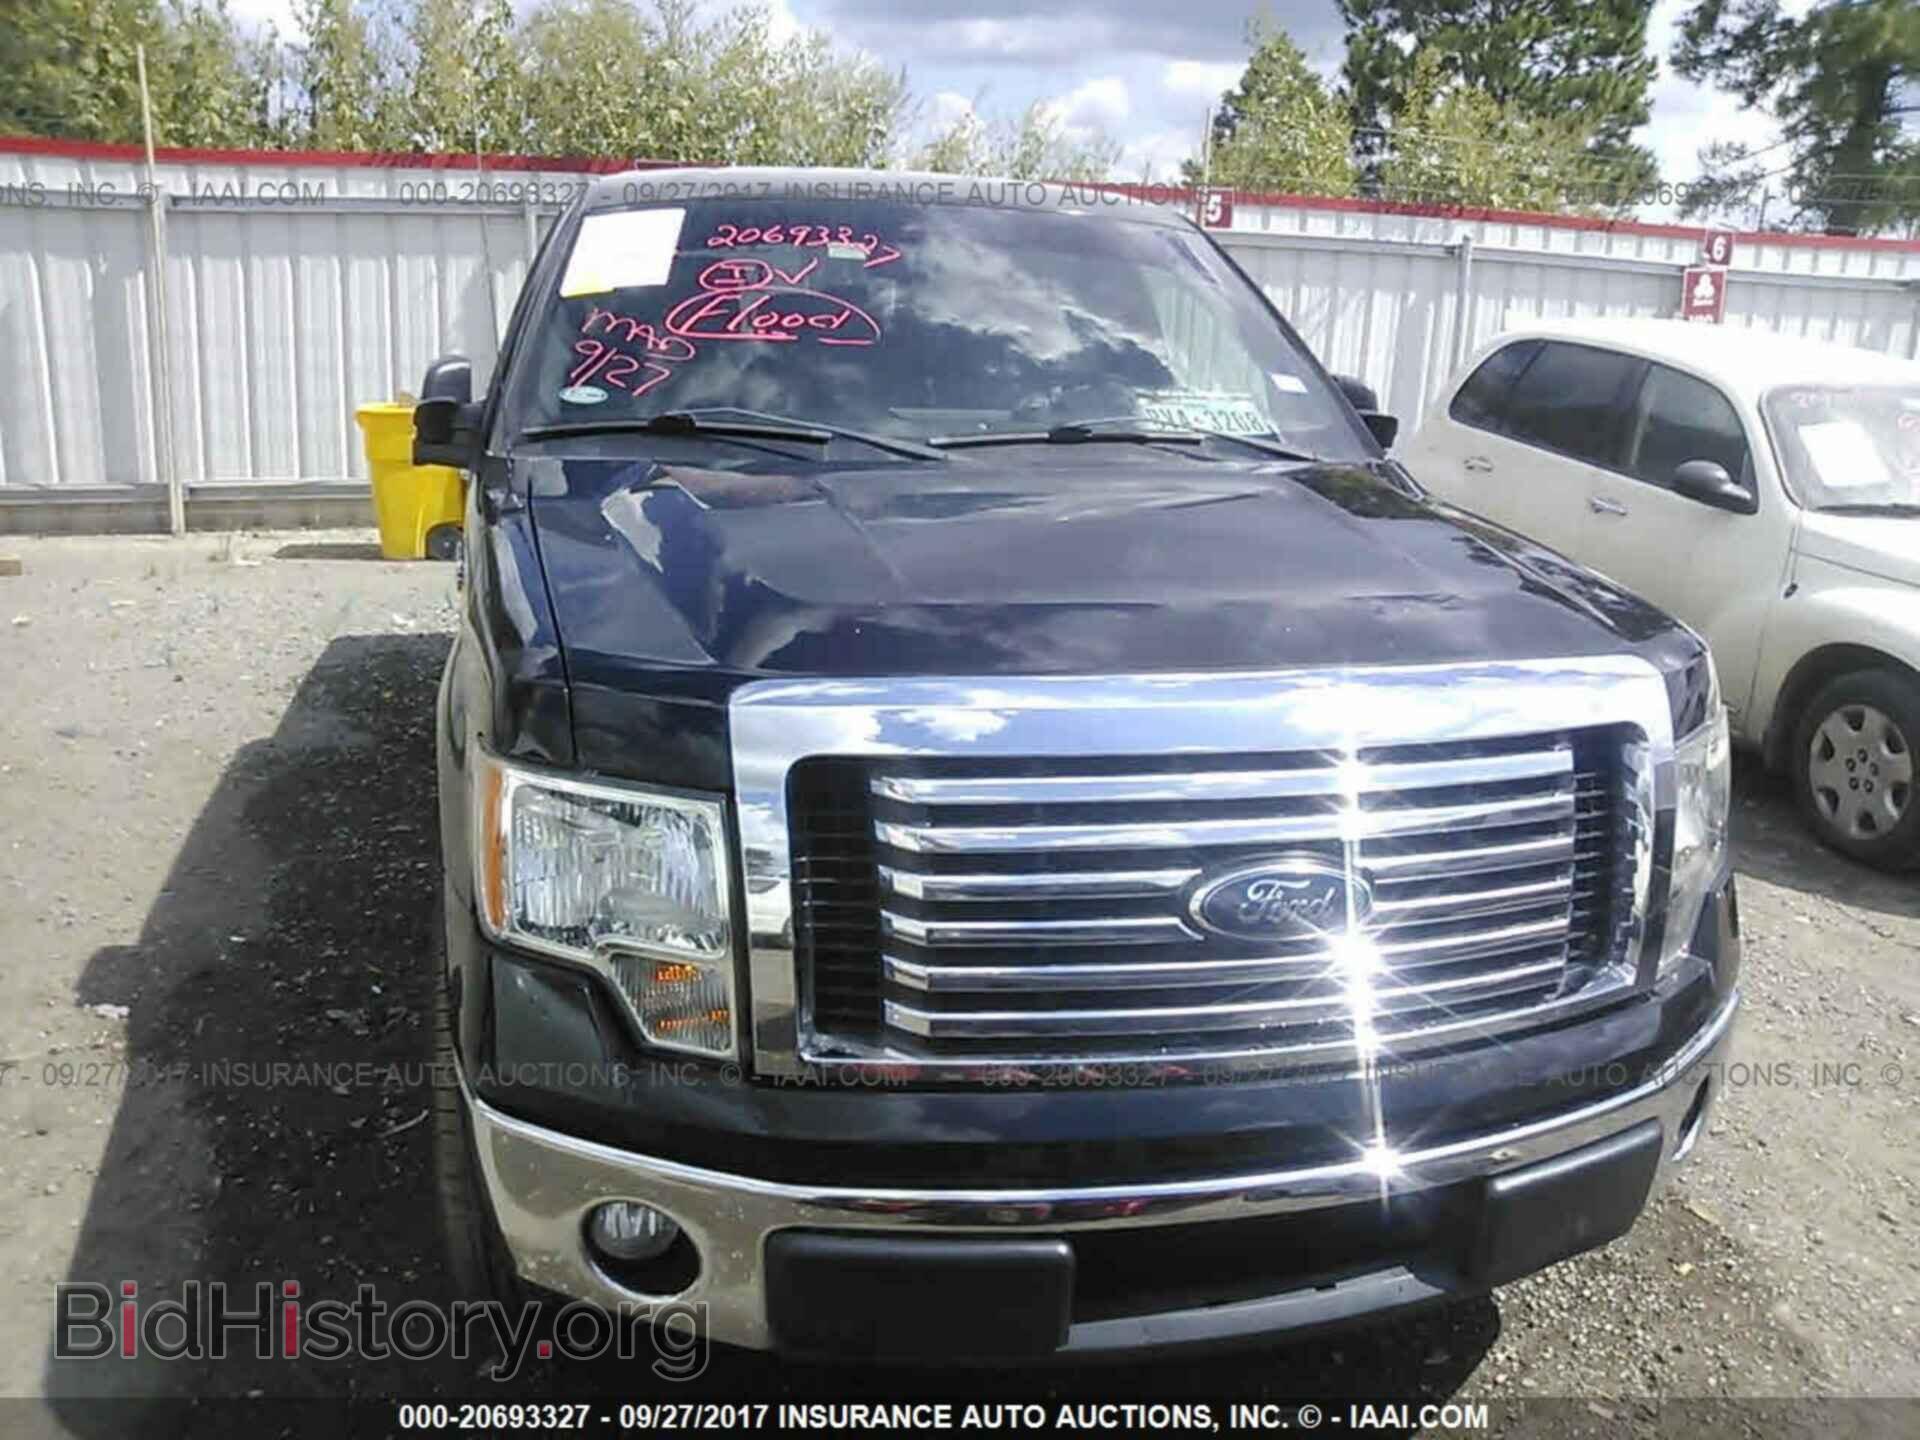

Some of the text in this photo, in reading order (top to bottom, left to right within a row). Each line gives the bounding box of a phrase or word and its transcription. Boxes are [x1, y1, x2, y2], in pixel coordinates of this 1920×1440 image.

[1205, 193, 1223, 223] 5
[1712, 235, 1727, 262] 6
[680, 293, 852, 333] Flood
[570, 340, 671, 397] 9/27
[1238, 879, 1337, 923] Ford
